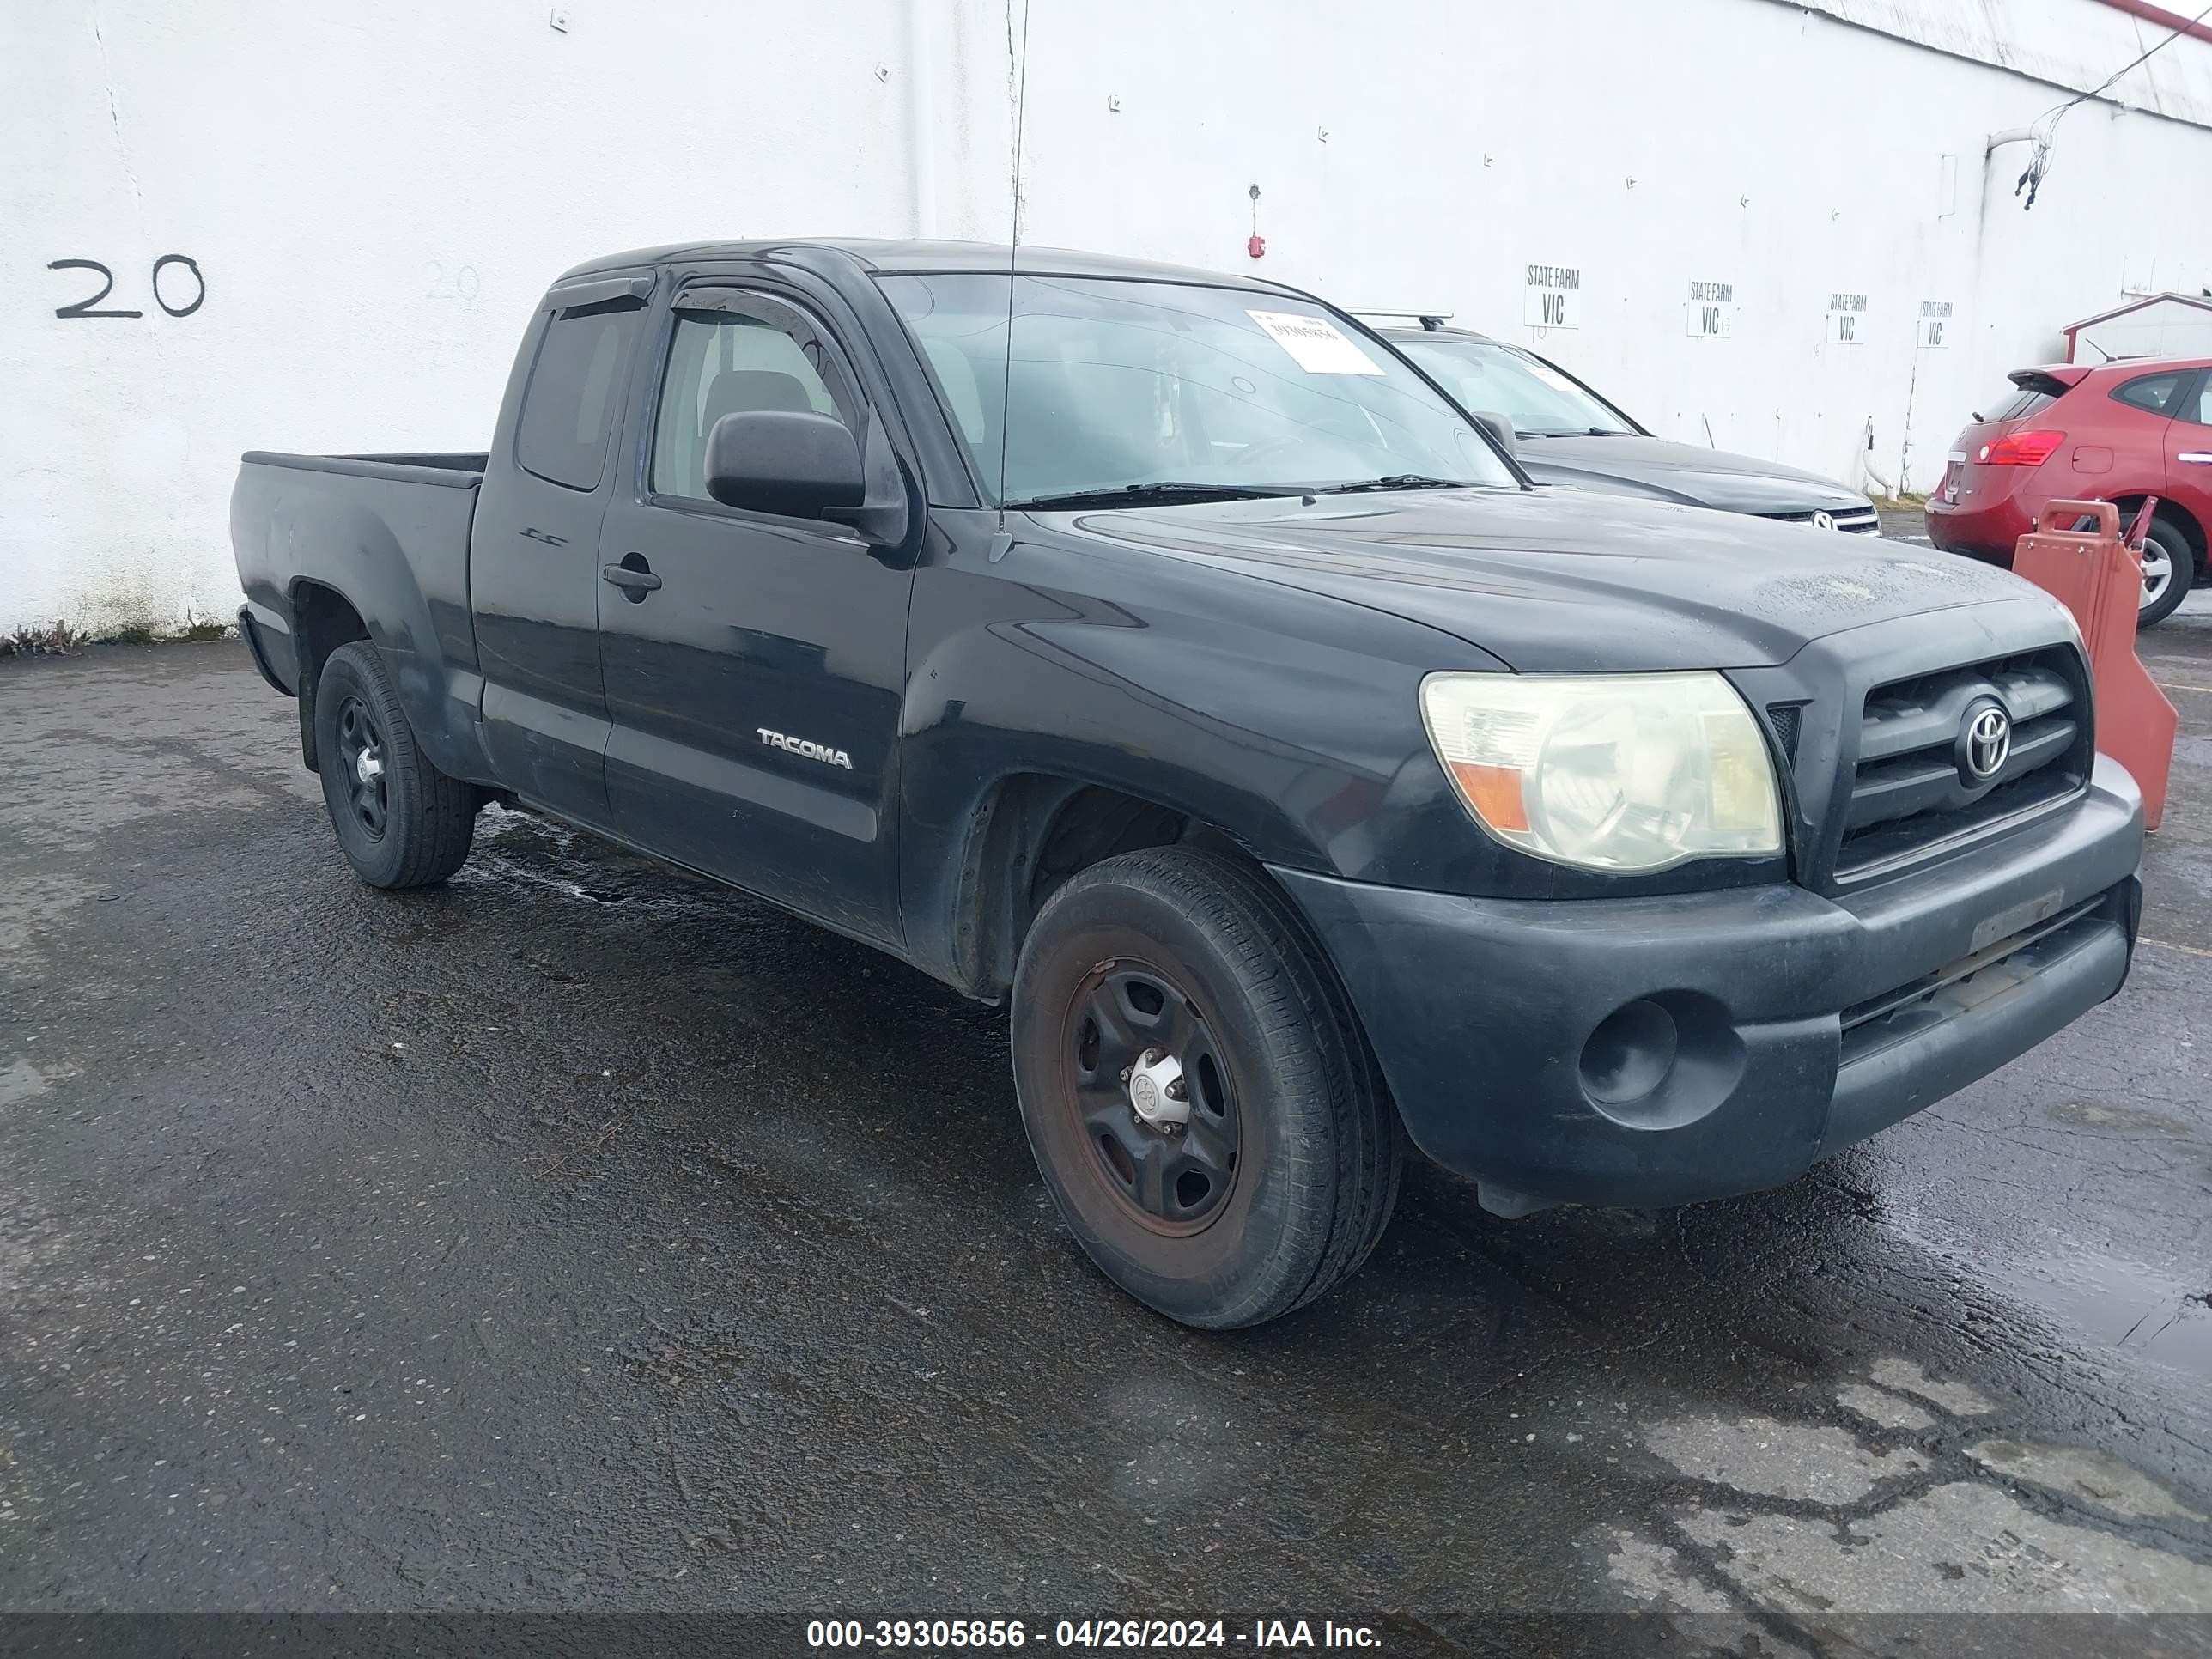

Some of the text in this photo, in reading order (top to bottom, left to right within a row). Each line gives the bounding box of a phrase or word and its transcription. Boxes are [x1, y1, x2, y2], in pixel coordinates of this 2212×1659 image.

[47, 254, 205, 319] 20
[1528, 264, 1580, 289] STATE FARM
[1691, 281, 1733, 302] STATE FARM
[1830, 293, 1867, 312] STATE FARM
[1542, 293, 1565, 325] VIC
[1702, 306, 1719, 334] VIC
[1922, 301, 1954, 318] STATE FARM
[1840, 315, 1855, 341] VIC
[1929, 321, 1942, 345] VIC
[757, 727, 854, 770] TACOMA
